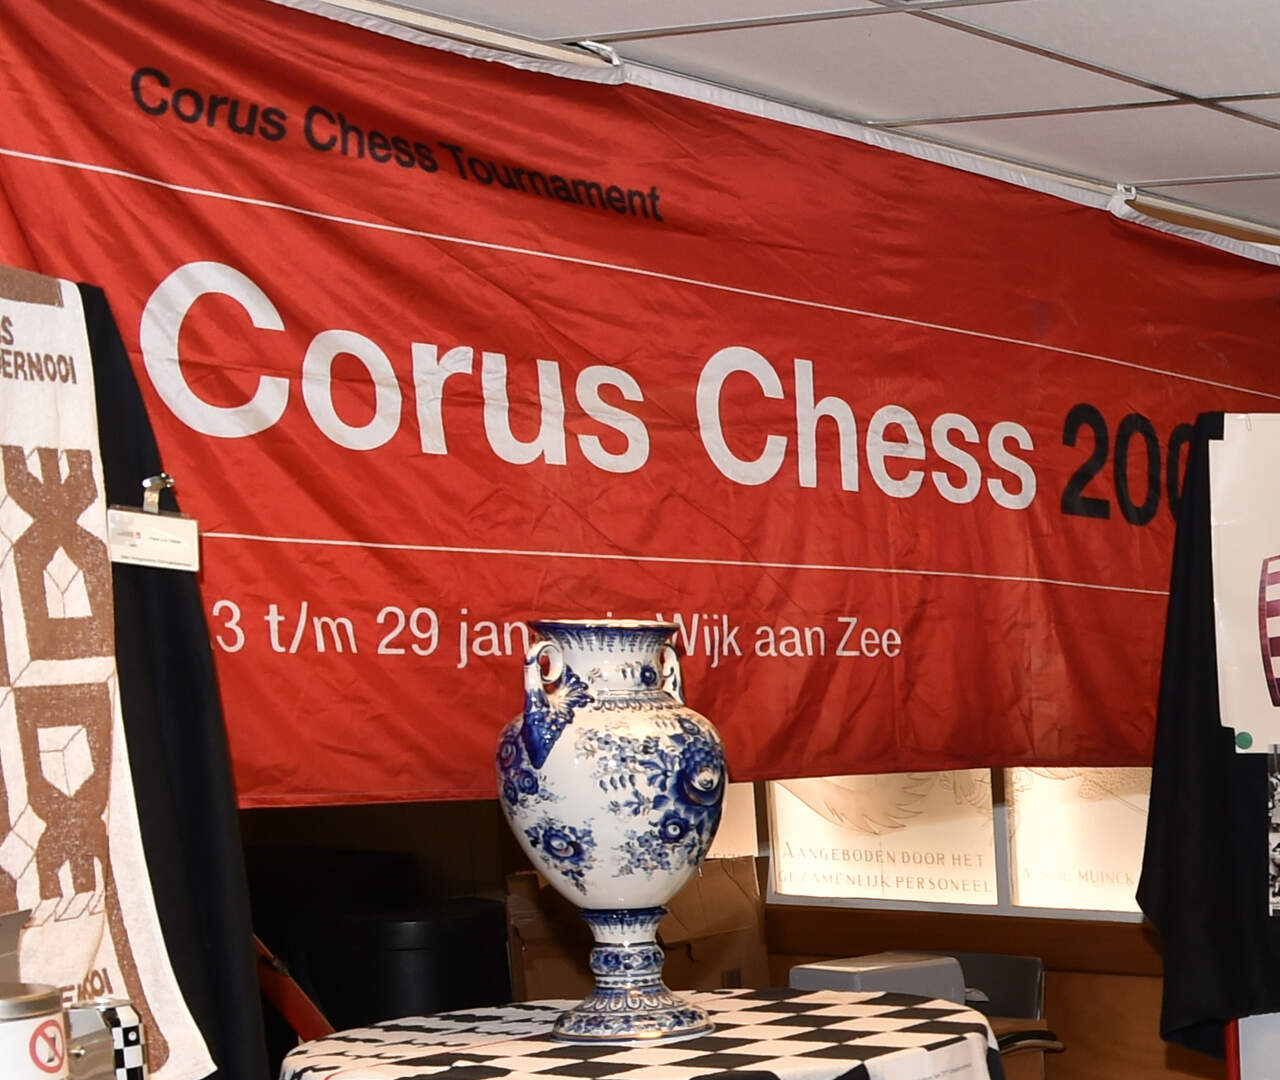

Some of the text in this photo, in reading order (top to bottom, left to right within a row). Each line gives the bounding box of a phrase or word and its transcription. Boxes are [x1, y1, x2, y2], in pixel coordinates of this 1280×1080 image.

[131, 67, 663, 221] Corus Chess Tournament
[0, 348, 77, 384] ERNOOI
[140, 261, 650, 473] Corus
[697, 346, 1037, 510] Chess
[267, 600, 358, 654] t/m
[377, 605, 439, 656] 29
[656, 613, 743, 667] Wijk
[755, 625, 825, 657] aan
[835, 616, 902, 657] Zee
[895, 876, 992, 894] PERSONEEL
[902, 851, 945, 867] DOOR
[952, 854, 985, 868] HET
